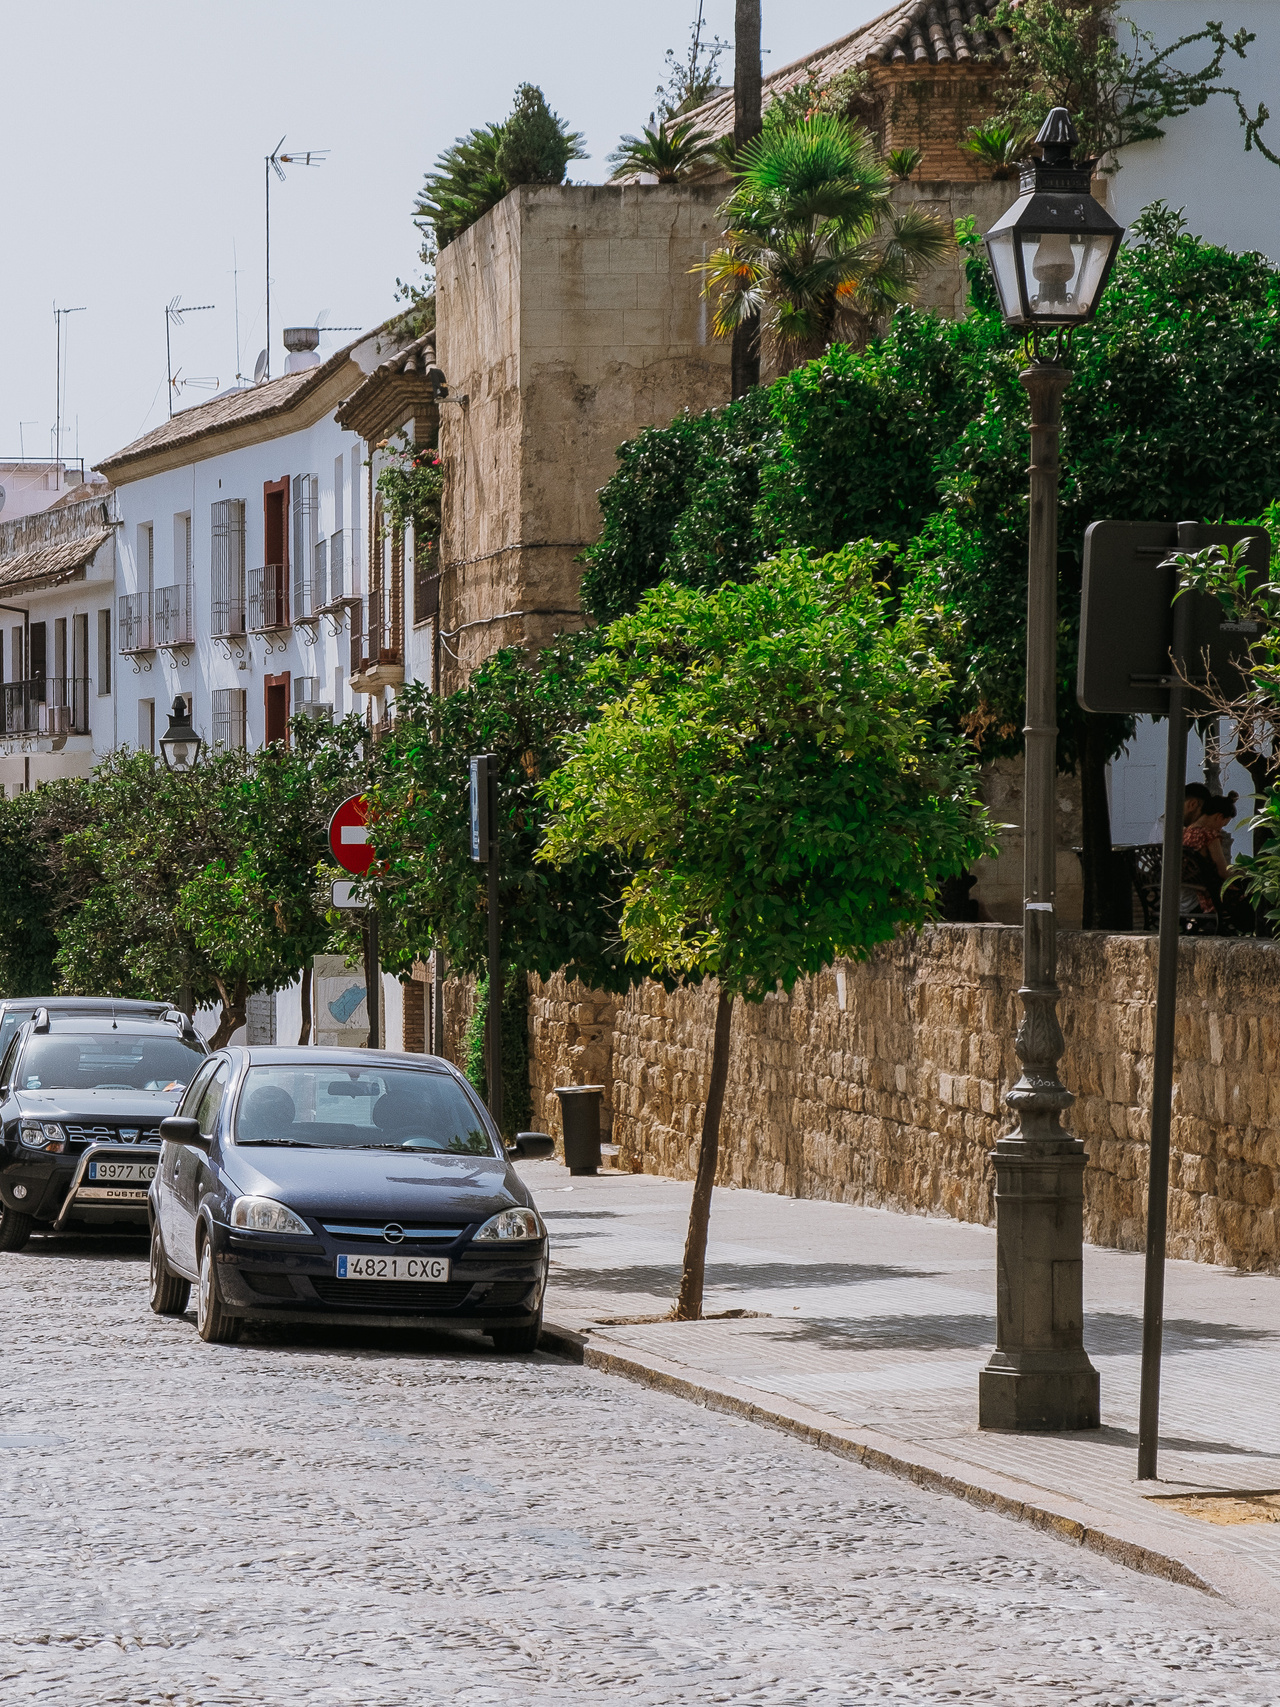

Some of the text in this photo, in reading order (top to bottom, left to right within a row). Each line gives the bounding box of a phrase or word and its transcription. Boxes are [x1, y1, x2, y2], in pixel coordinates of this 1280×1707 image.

[99, 1164, 156, 1179] 9977 KG
[106, 1190, 149, 1198] DUSTER
[352, 1258, 441, 1278] 4821 CXG
